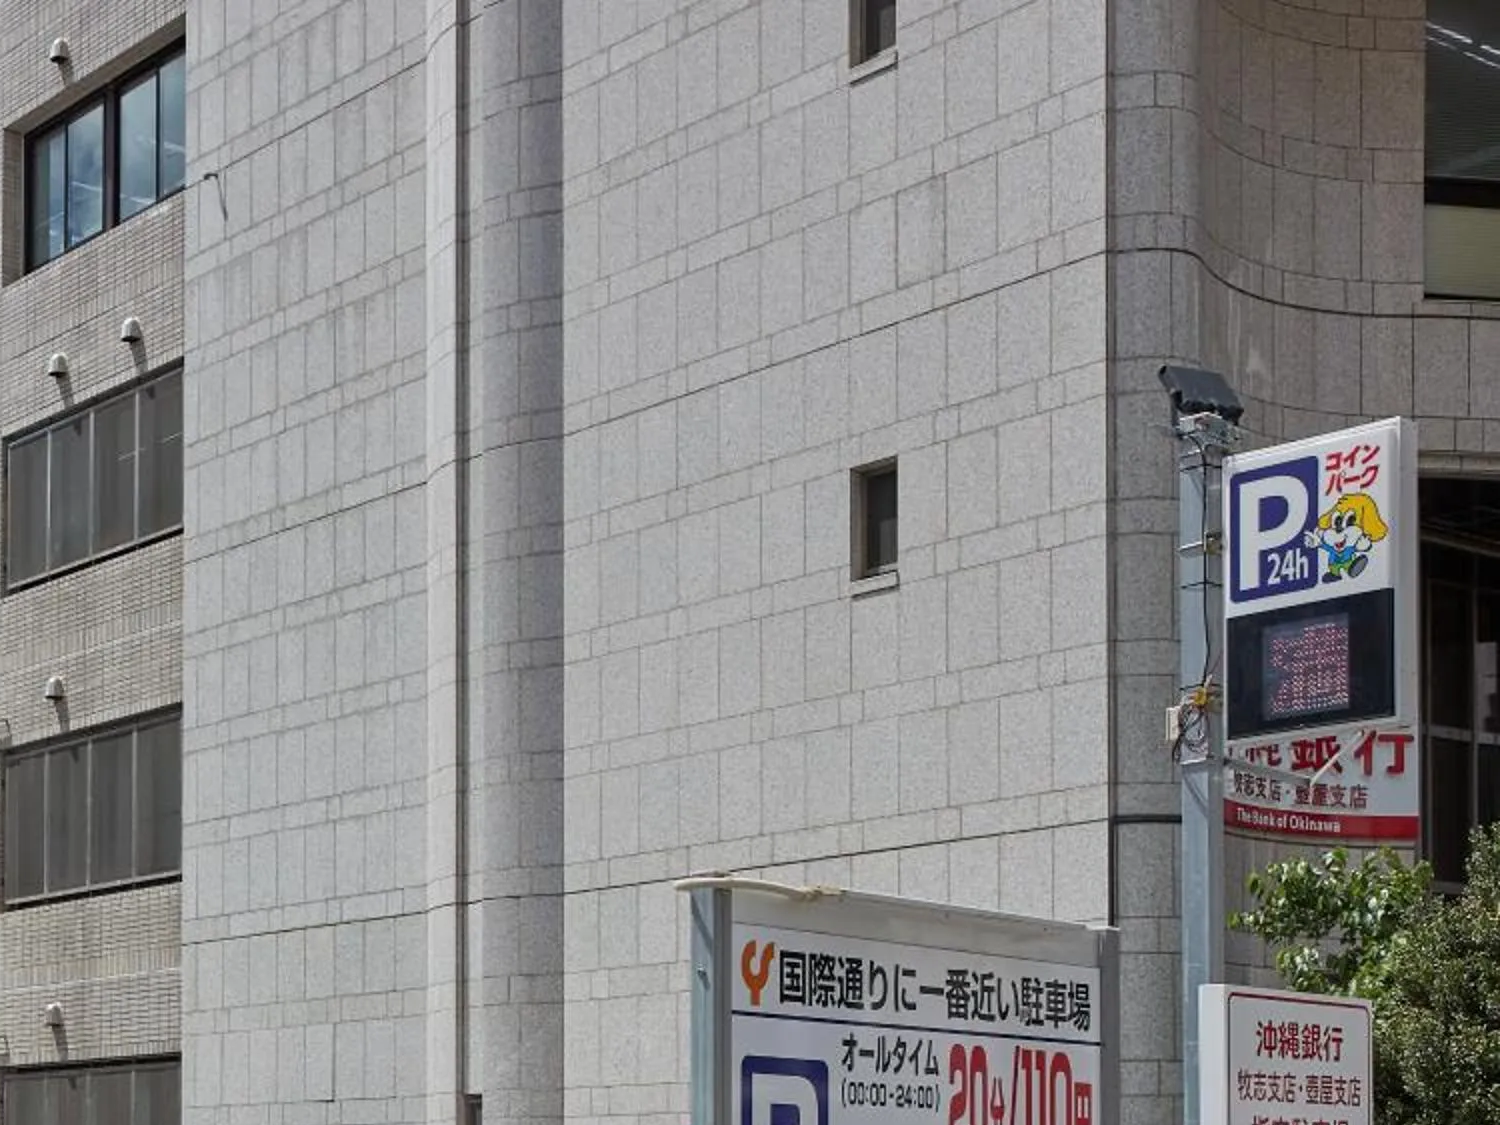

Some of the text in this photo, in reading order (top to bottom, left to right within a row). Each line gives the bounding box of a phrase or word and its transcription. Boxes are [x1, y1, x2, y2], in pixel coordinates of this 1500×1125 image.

[1325, 444, 1380, 472] コイン
[1325, 464, 1380, 496] パーク
[1238, 475, 1309, 591] P
[1267, 553, 1309, 586] 24h
[1236, 807, 1341, 833] The Bank of Okinawa
[779, 949, 1091, 1032] 国際通りに一番近い駐車場
[841, 1032, 940, 1077] オールタイム
[1256, 1020, 1343, 1063] 沖縄銀行
[1237, 1069, 1361, 1107] 牧志支店・壺屋支店
